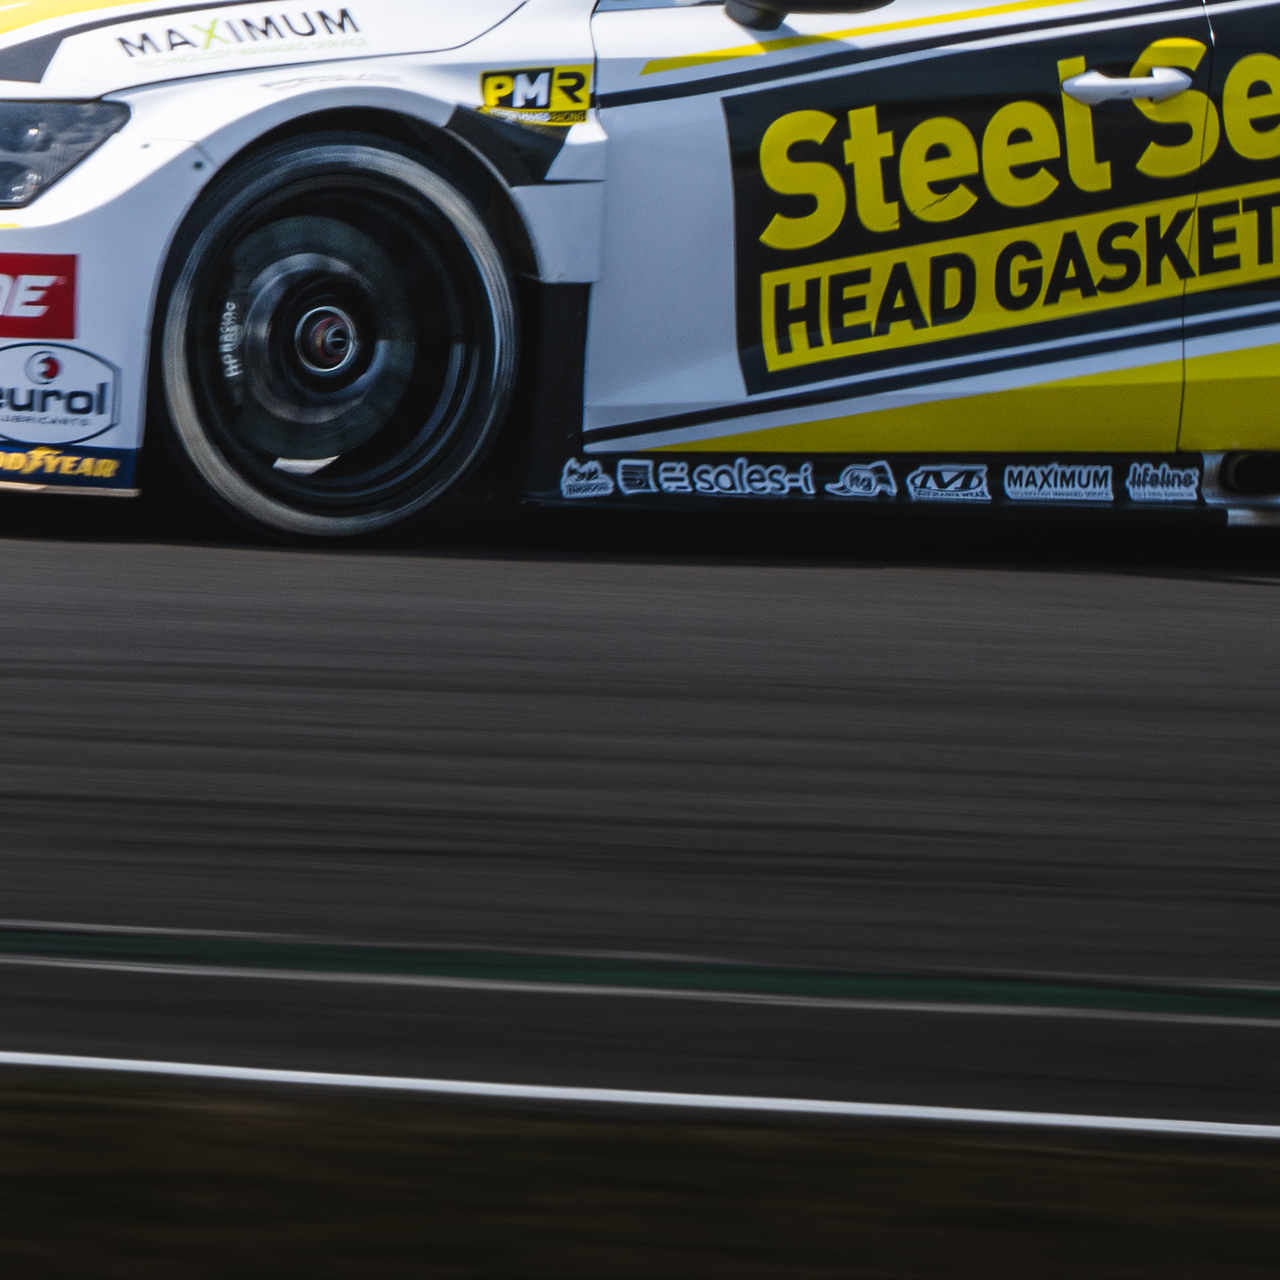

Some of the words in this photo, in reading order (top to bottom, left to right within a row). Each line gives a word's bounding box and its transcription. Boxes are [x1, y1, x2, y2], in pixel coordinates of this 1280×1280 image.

[115, 8, 360, 58] MAXIMUM
[485, 71, 586, 117] PMR
[759, 55, 1111, 250] Steel
[774, 252, 976, 354] HEAD
[696, 459, 813, 493] sales-i
[1007, 465, 1110, 492] MAXIMUM
[1131, 466, 1194, 488] lifeline
